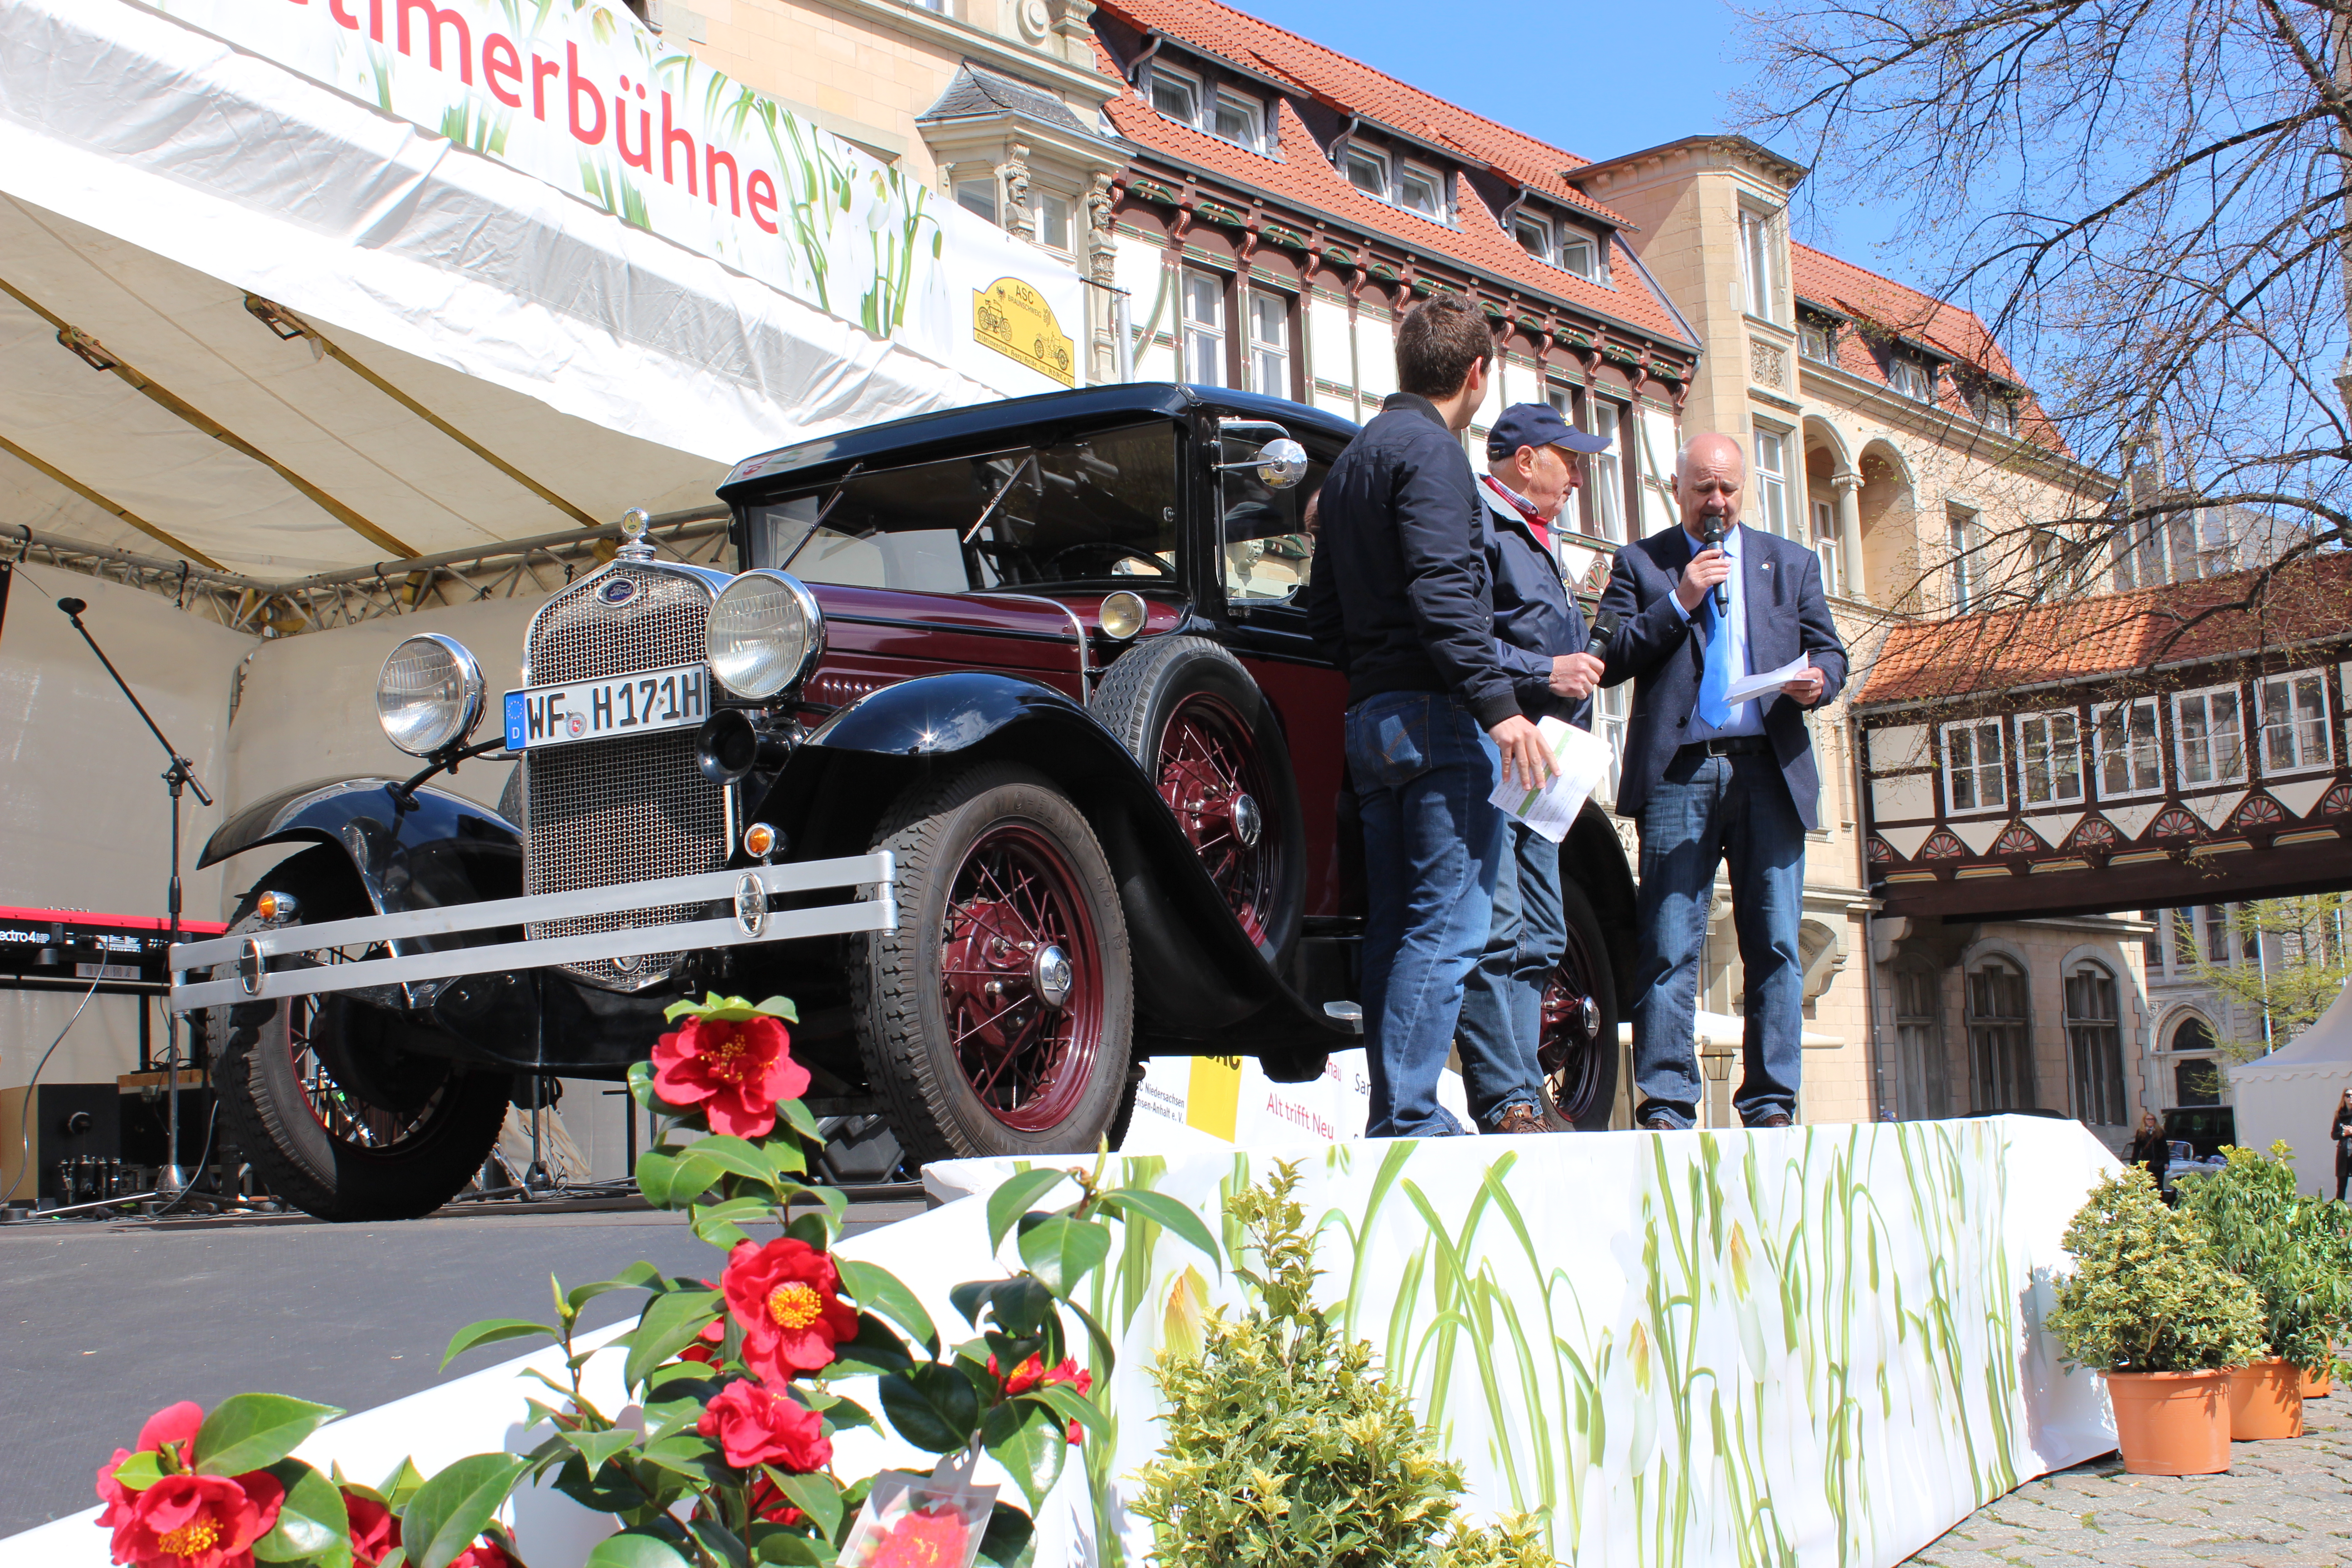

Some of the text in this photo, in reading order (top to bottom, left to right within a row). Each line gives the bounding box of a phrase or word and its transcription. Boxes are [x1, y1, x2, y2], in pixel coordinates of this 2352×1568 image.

[1008, 294, 1042, 318] BRAUNSCHWEIG
[1016, 284, 1034, 304] ASC
[977, 333, 1008, 353] Oldtimerclub
[1011, 349, 1037, 368] Harz/Heide
[1039, 363, 1045, 372] im
[1049, 368, 1063, 381] ADAC
[610, 584, 633, 597] Ford
[527, 692, 566, 740] WF
[512, 727, 520, 740] D
[994, 791, 1076, 839] MICHELIN
[1112, 931, 1125, 951] 19
[1323, 1054, 1341, 1082] hau
[1145, 1082, 1185, 1108] Niedersachsen
[1266, 1092, 1333, 1141] Alt trifft Neu
